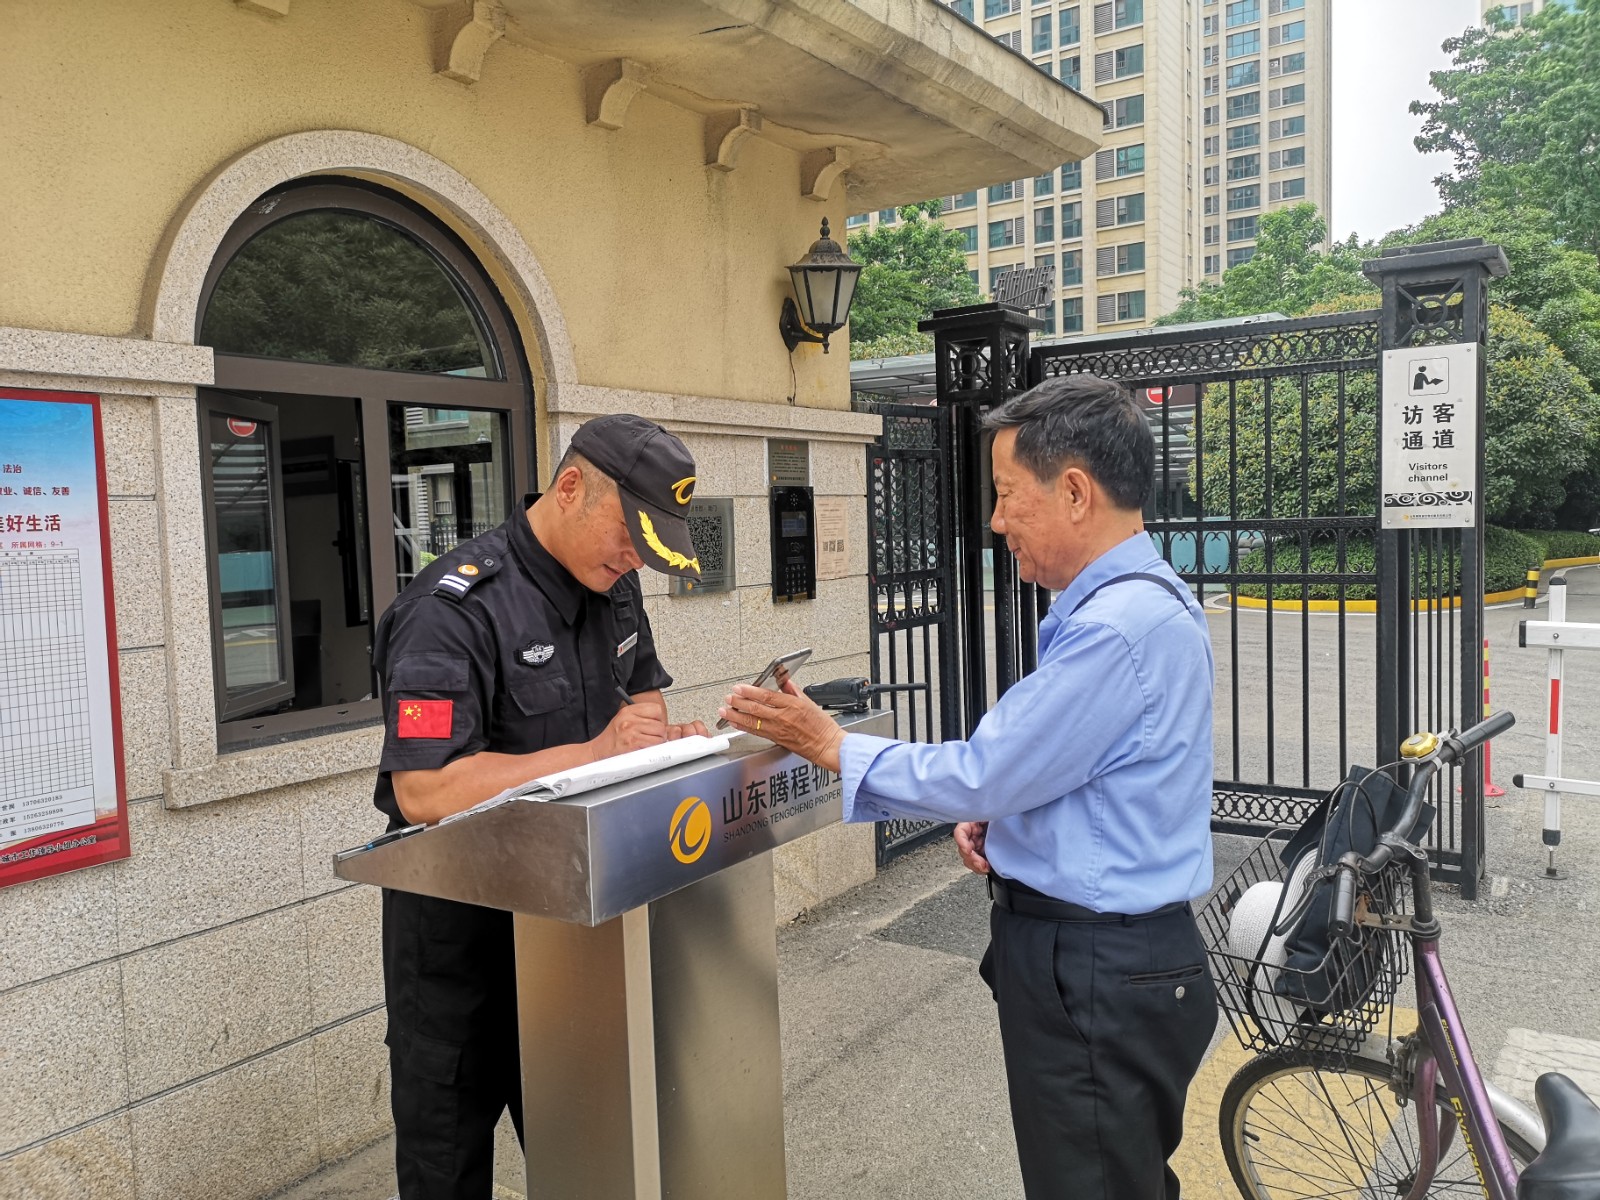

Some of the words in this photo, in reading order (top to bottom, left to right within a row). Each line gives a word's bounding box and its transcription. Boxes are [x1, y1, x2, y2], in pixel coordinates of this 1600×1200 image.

[1402, 403, 1455, 425] 访客
[1402, 429, 1455, 450] 通道
[3, 464, 22, 474] 法治
[1408, 462, 1448, 471] Visitors
[1408, 473, 1448, 482] channel
[0, 486, 70, 496] 业、诚信、友善
[723, 816, 769, 843] SHANDONG
[770, 799, 814, 825] TENGCHENG
[814, 788, 843, 808] PROPER
